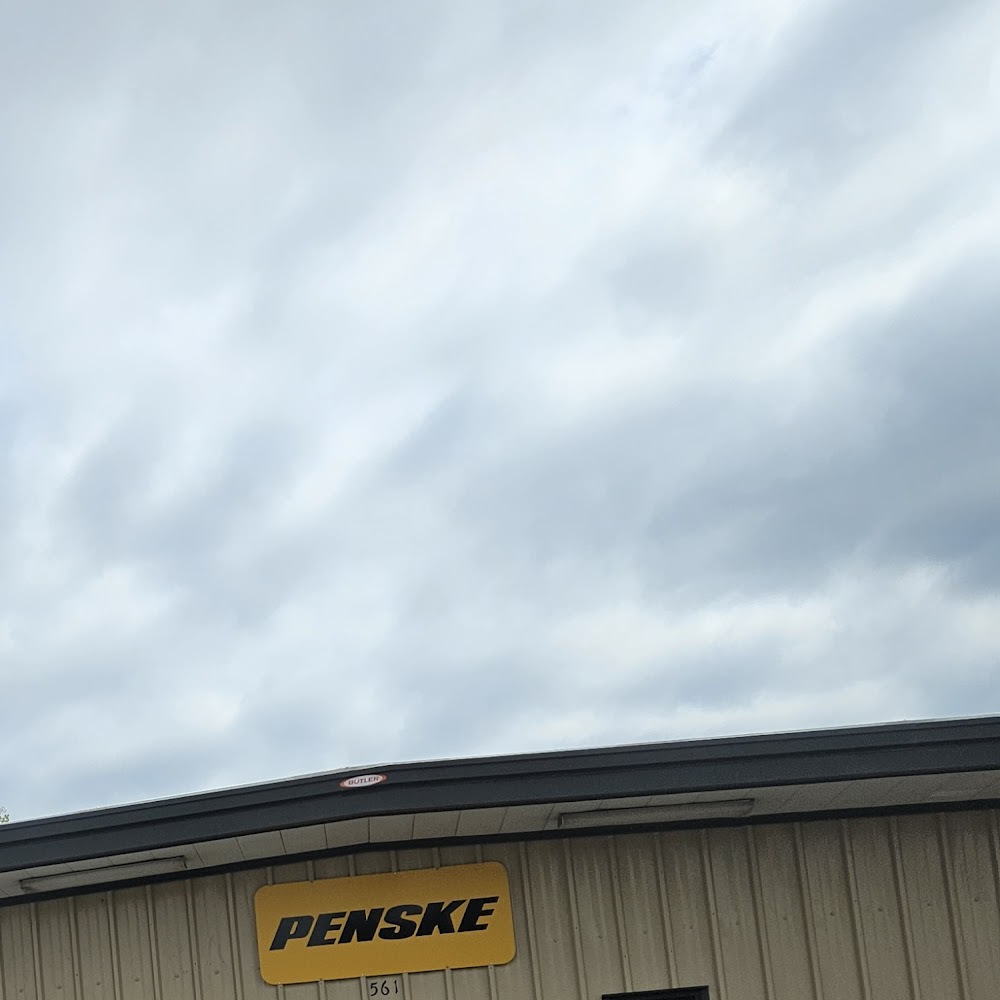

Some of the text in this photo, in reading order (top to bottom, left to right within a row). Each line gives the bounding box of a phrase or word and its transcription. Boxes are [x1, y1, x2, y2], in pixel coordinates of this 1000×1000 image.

[348, 776, 380, 786] BUTLER
[269, 896, 500, 951] PENSKE
[370, 980, 399, 996] 561
